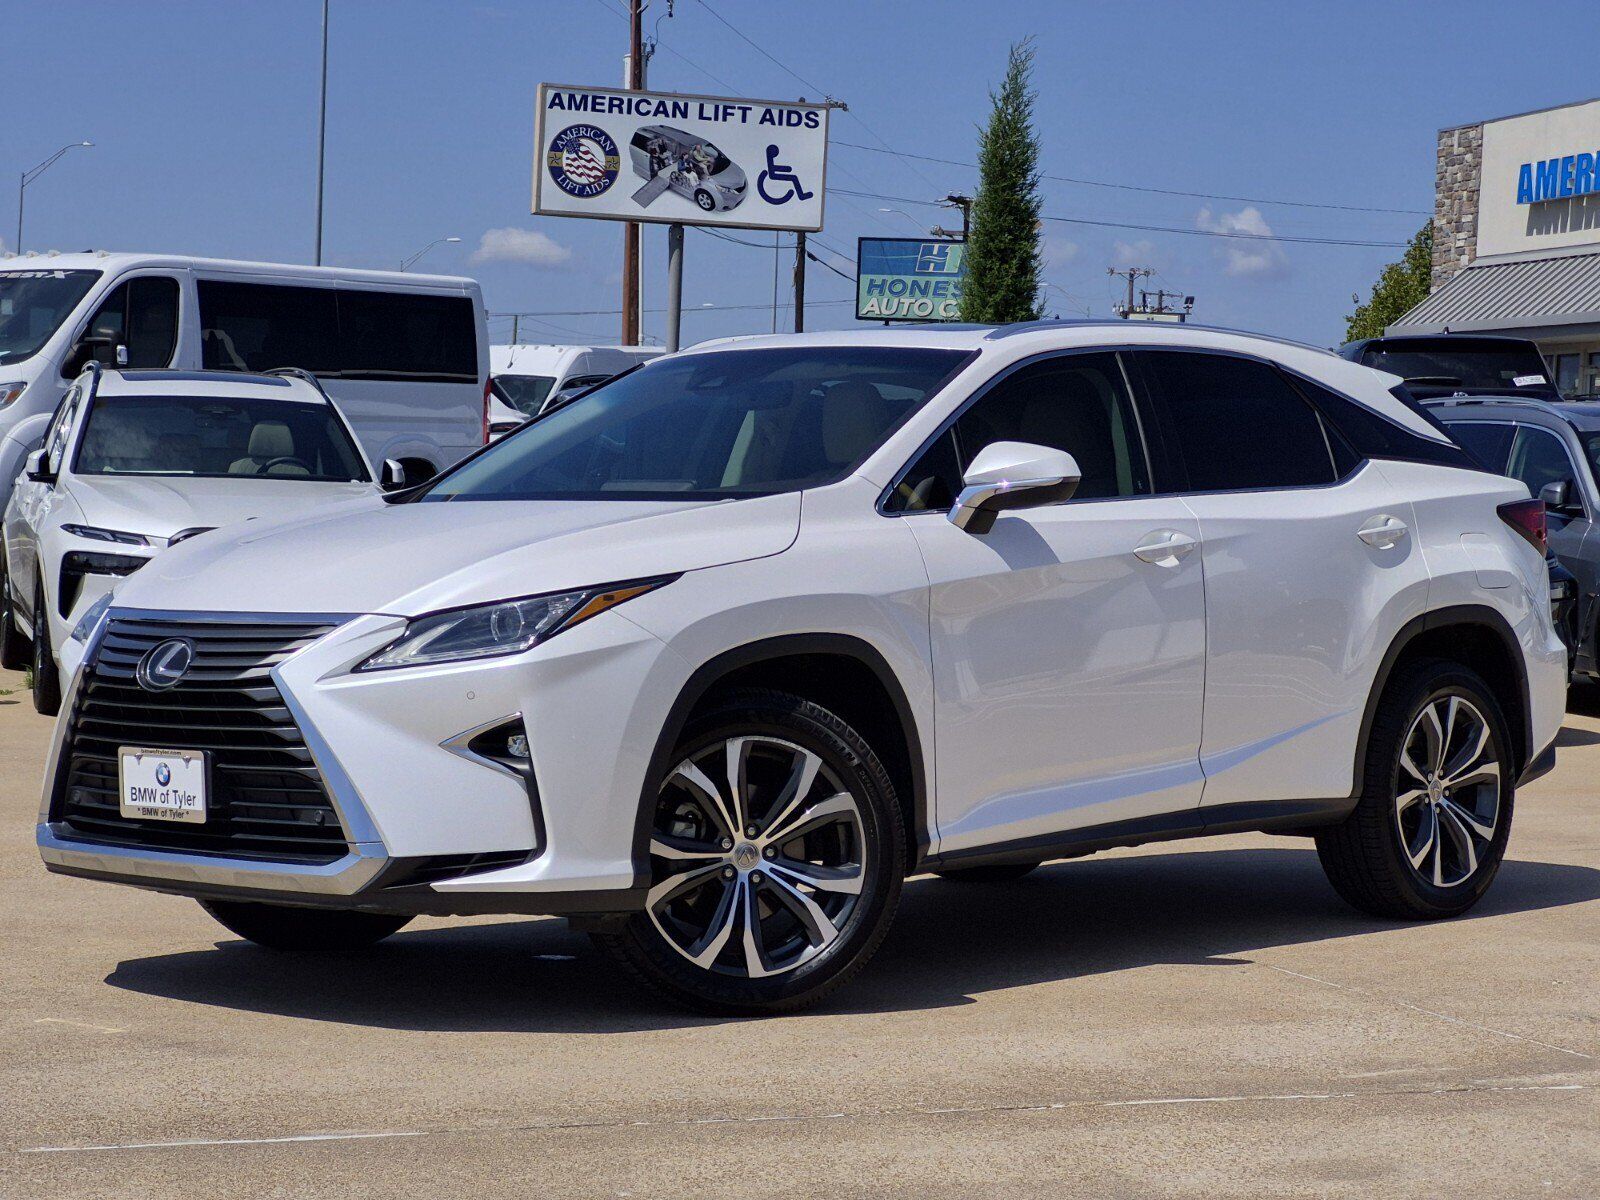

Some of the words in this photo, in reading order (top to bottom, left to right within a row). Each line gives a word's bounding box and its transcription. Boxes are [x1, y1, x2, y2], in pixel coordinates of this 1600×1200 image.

[547, 92, 689, 119] AMERICAN
[698, 103, 752, 123] LIFT
[759, 108, 820, 129] AIDS
[556, 126, 614, 151] AMERICAN
[557, 175, 582, 194] LIFT
[584, 176, 610, 195] AIDS
[860, 298, 934, 317] AUTO
[938, 299, 961, 318] C
[130, 786, 157, 803] BMW
[160, 789, 170, 804] of
[172, 789, 197, 810] Tyler
[141, 807, 160, 817] BMW
[160, 809, 168, 817] of
[169, 809, 185, 819] Tyler
